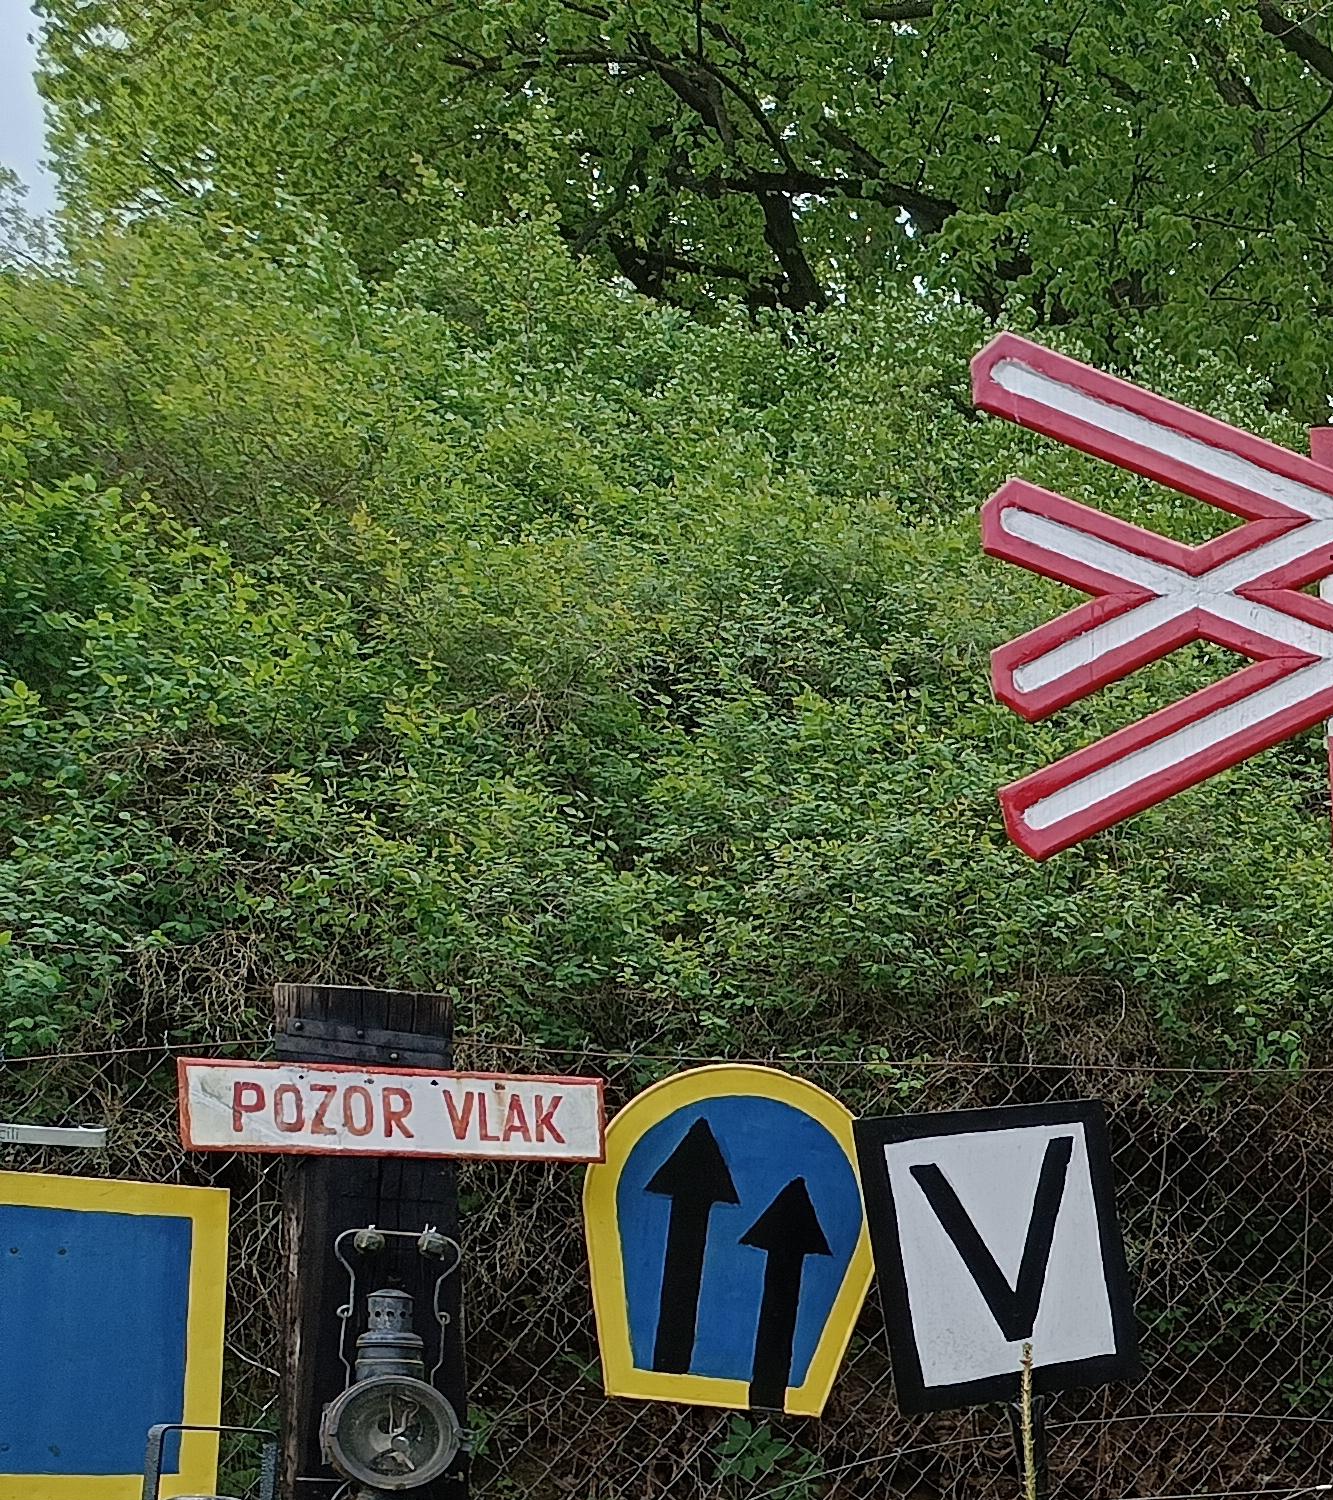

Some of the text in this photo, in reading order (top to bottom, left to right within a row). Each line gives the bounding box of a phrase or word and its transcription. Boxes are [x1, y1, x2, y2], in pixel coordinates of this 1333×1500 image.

[232, 1081, 566, 1144] POZOR VLAK
[909, 1136, 1074, 1343] V
